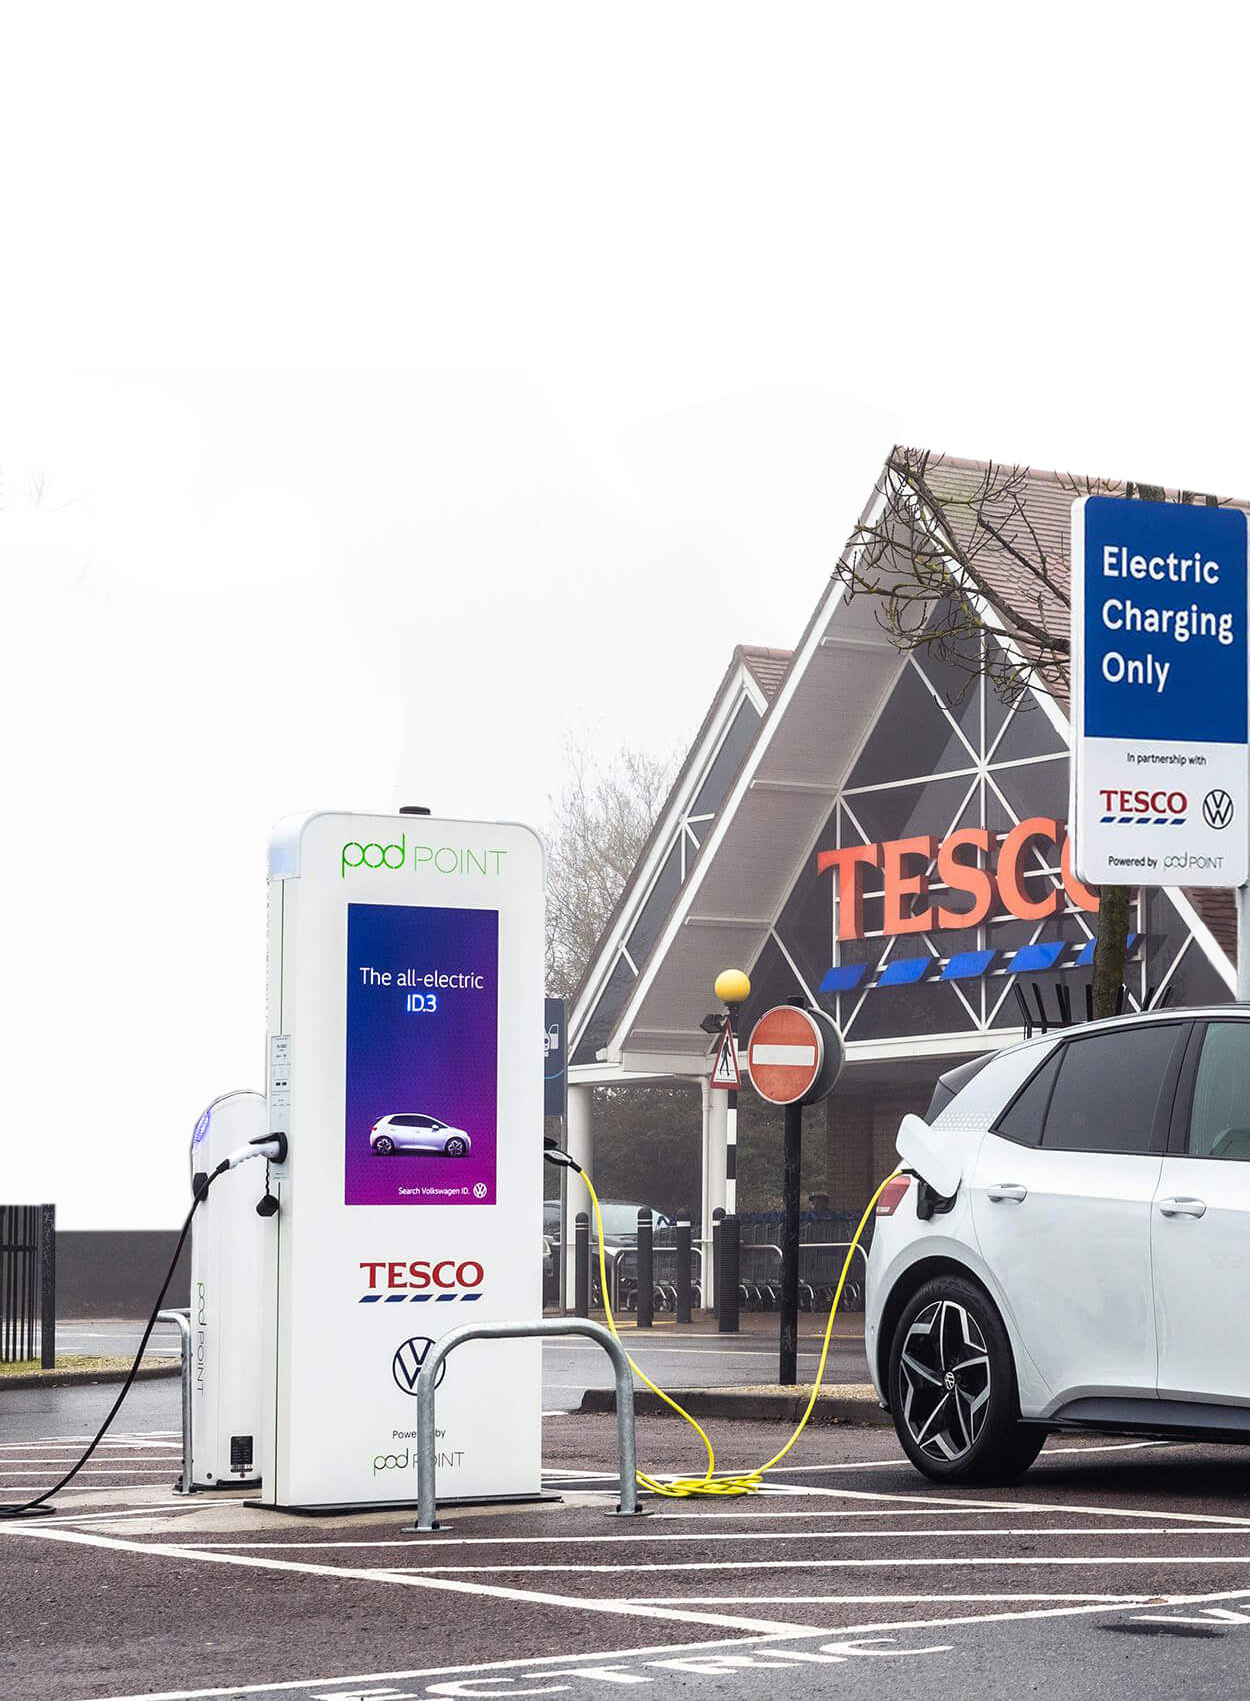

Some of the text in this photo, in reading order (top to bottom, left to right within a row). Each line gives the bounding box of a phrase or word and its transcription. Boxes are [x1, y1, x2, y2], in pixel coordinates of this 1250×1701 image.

[1102, 545, 1220, 585] Electric
[1102, 598, 1235, 646] Charging
[1101, 651, 1171, 694] Only
[1126, 752, 1207, 767] In partnership with
[1100, 789, 1188, 815] TESCO
[341, 832, 507, 879] pod POINT
[1108, 855, 1145, 868] Powered
[1146, 856, 1158, 870] by
[1189, 856, 1225, 870] POINT
[359, 966, 485, 990] The all-electric
[406, 993, 438, 1013] ID.3
[398, 1186, 421, 1196] Search
[421, 1186, 460, 1197] Volkswagen
[359, 1260, 485, 1289] TESCO
[196, 1330, 206, 1398] POINT
[434, 1428, 447, 1440] by
[372, 1447, 409, 1477] pod
